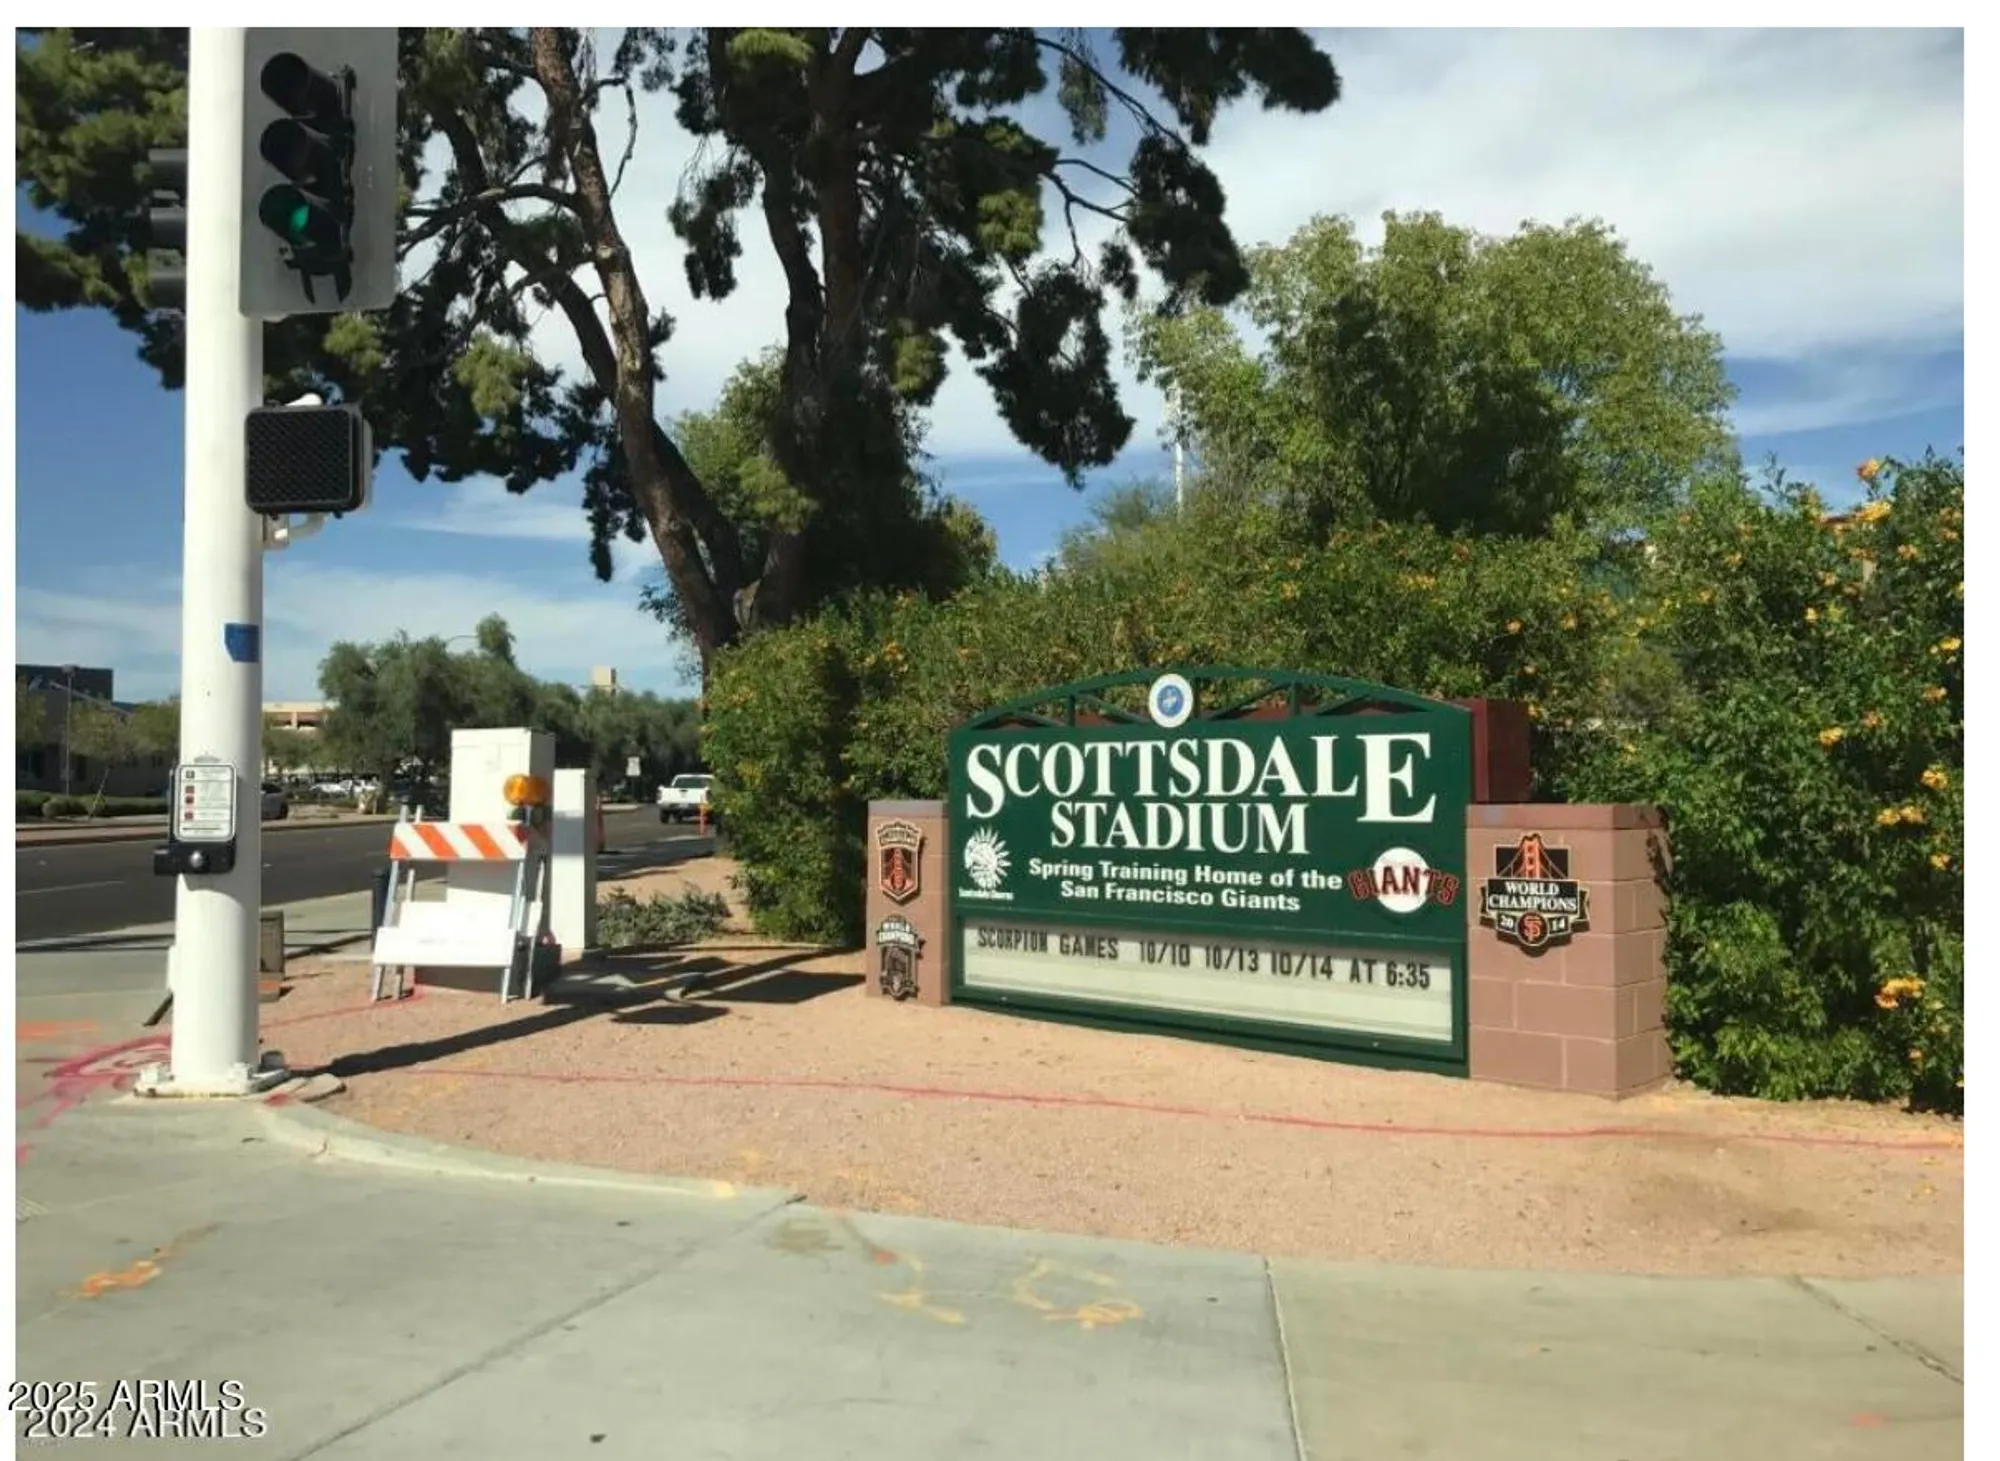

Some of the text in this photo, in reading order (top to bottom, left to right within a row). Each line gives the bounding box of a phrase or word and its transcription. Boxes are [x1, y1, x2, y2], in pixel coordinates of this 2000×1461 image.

[966, 732, 1437, 824] SCOTTSDALE
[1051, 801, 1310, 855] STADIUM
[1028, 857, 1343, 890] Spring Training Home of the
[1348, 865, 1461, 906] GIANTS
[1505, 881, 1560, 896] WORLD
[1060, 880, 1301, 912] San Francisco Giants
[1488, 894, 1578, 911] CHAMPIONS
[977, 926, 1432, 990] SCORPION GAMES 10/10 10/13 10/14 AT 6:35
